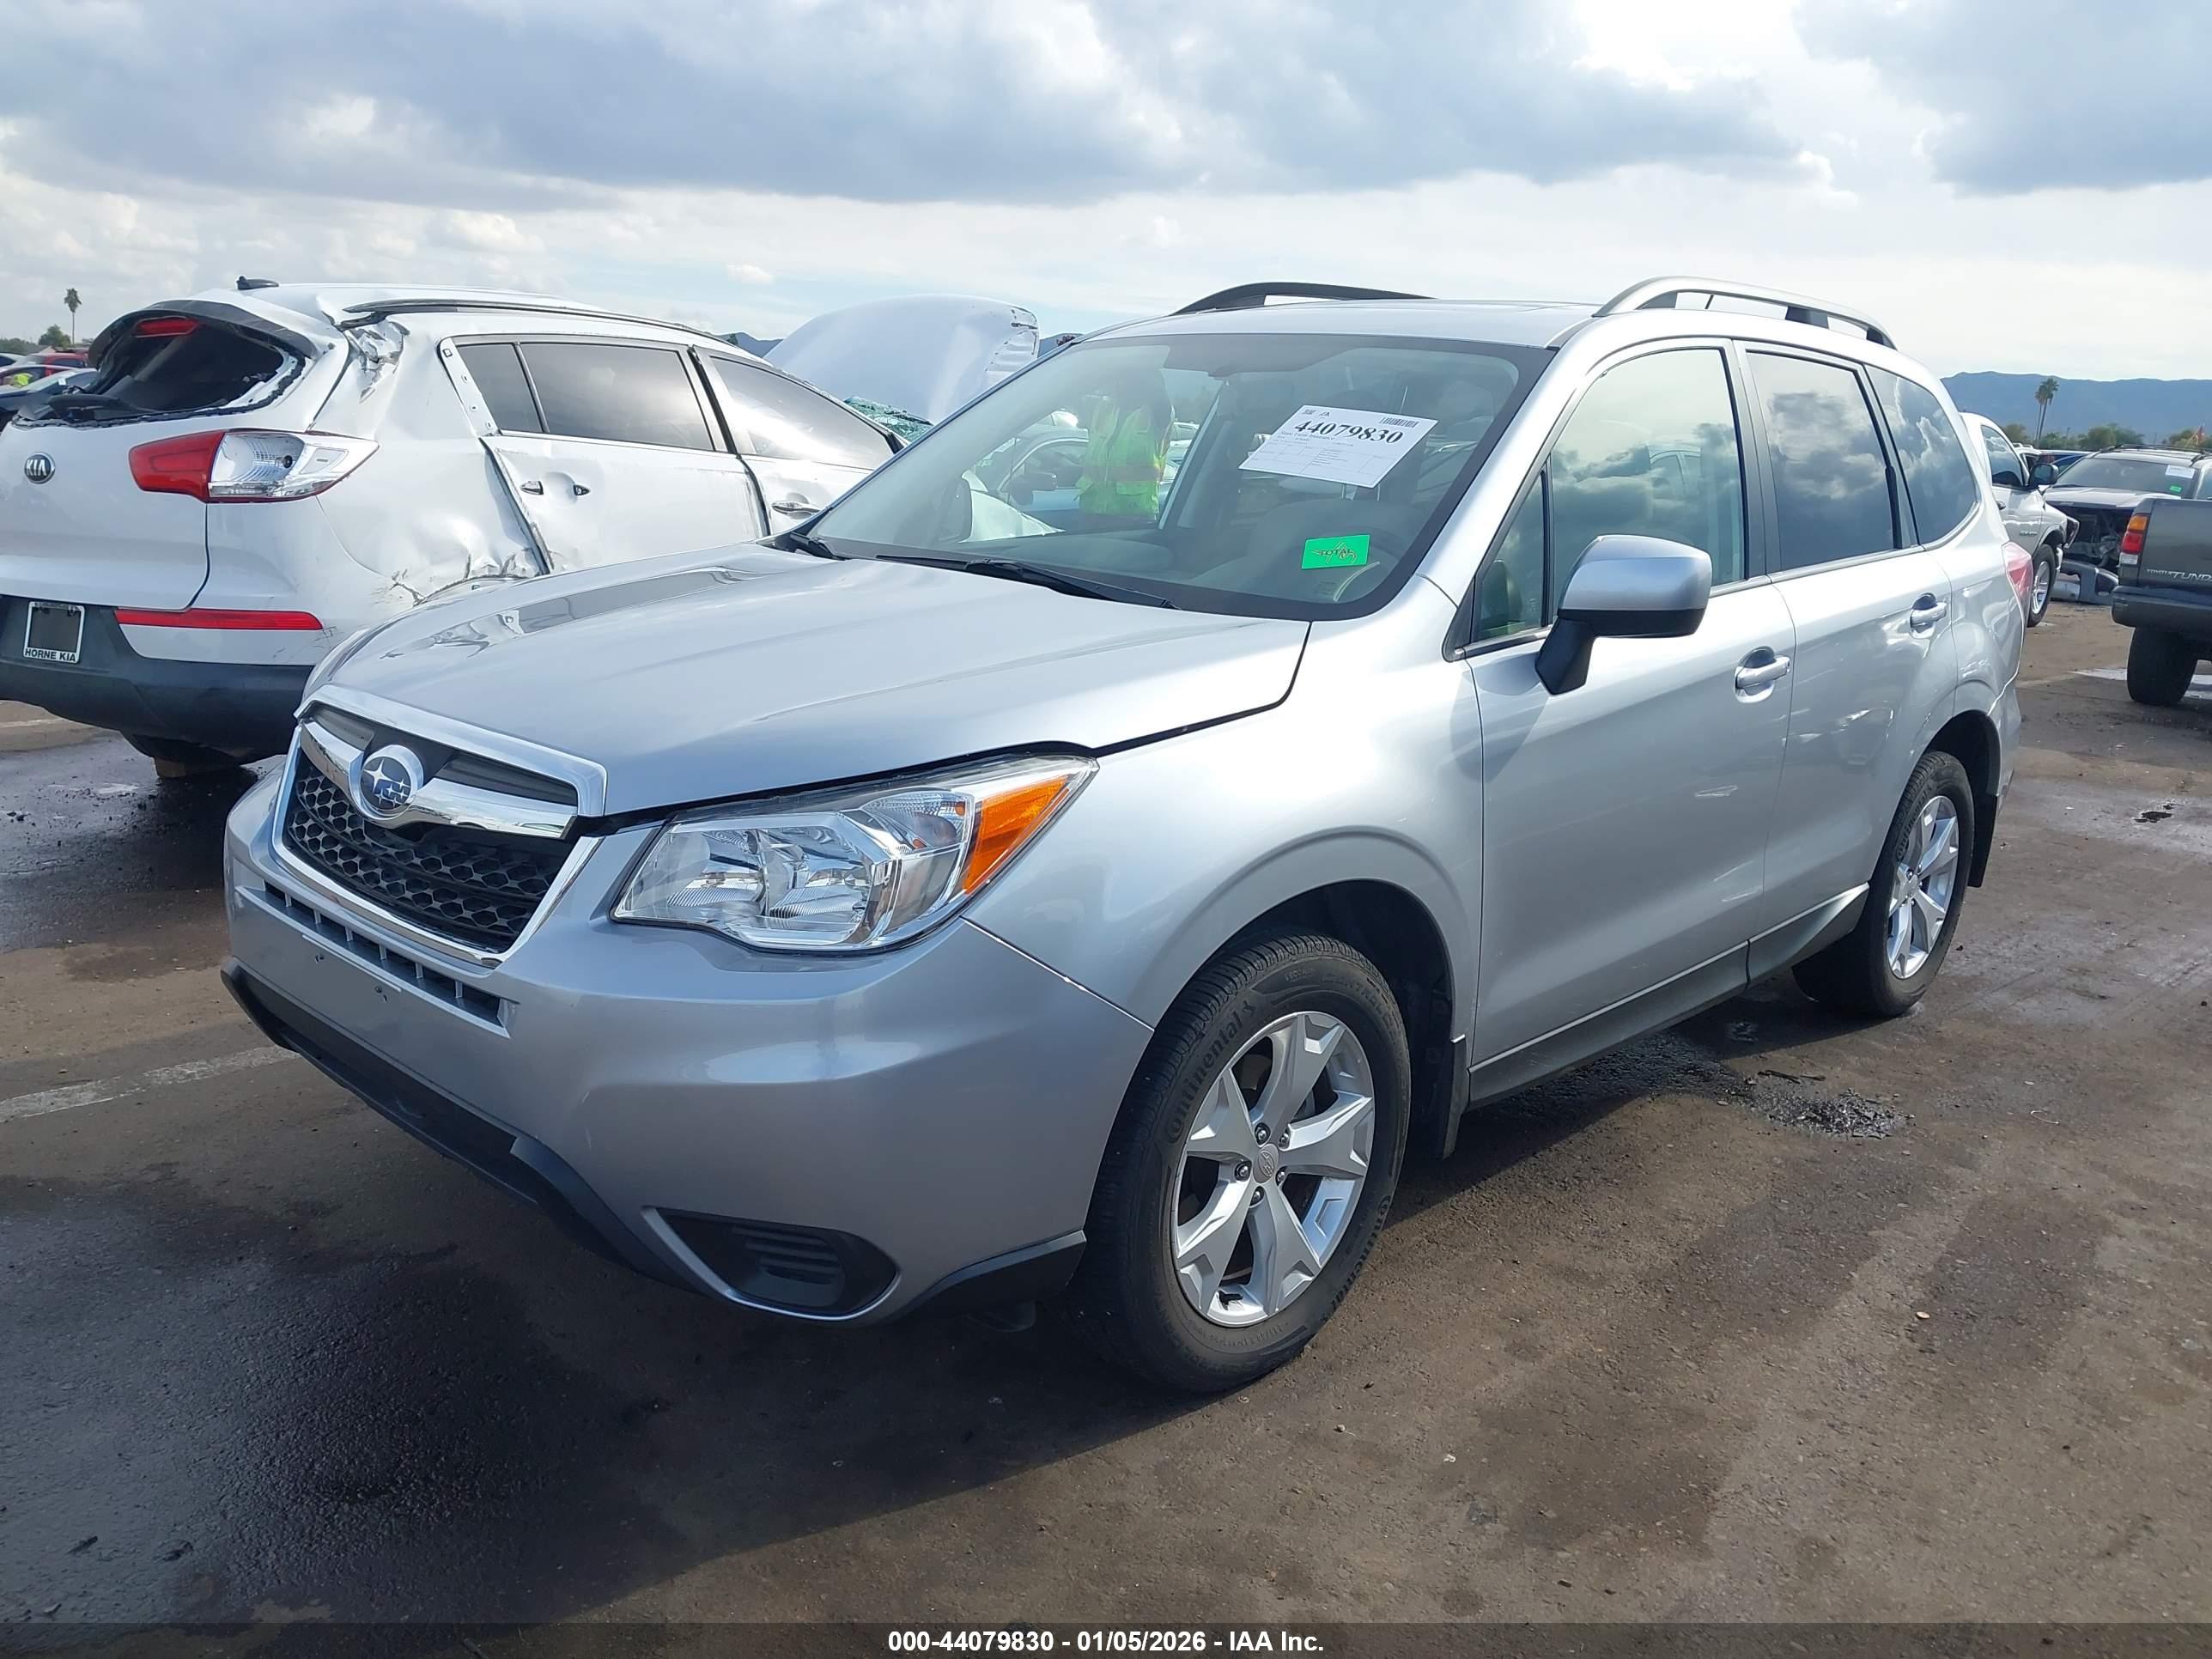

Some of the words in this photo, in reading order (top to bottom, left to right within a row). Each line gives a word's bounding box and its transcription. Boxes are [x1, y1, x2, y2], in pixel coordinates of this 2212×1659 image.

[1295, 421, 1404, 444] 44079830
[26, 459, 47, 476] KIA
[2169, 571, 2212, 582] TUND
[25, 648, 57, 660] HORNE
[59, 652, 76, 663] KIA
